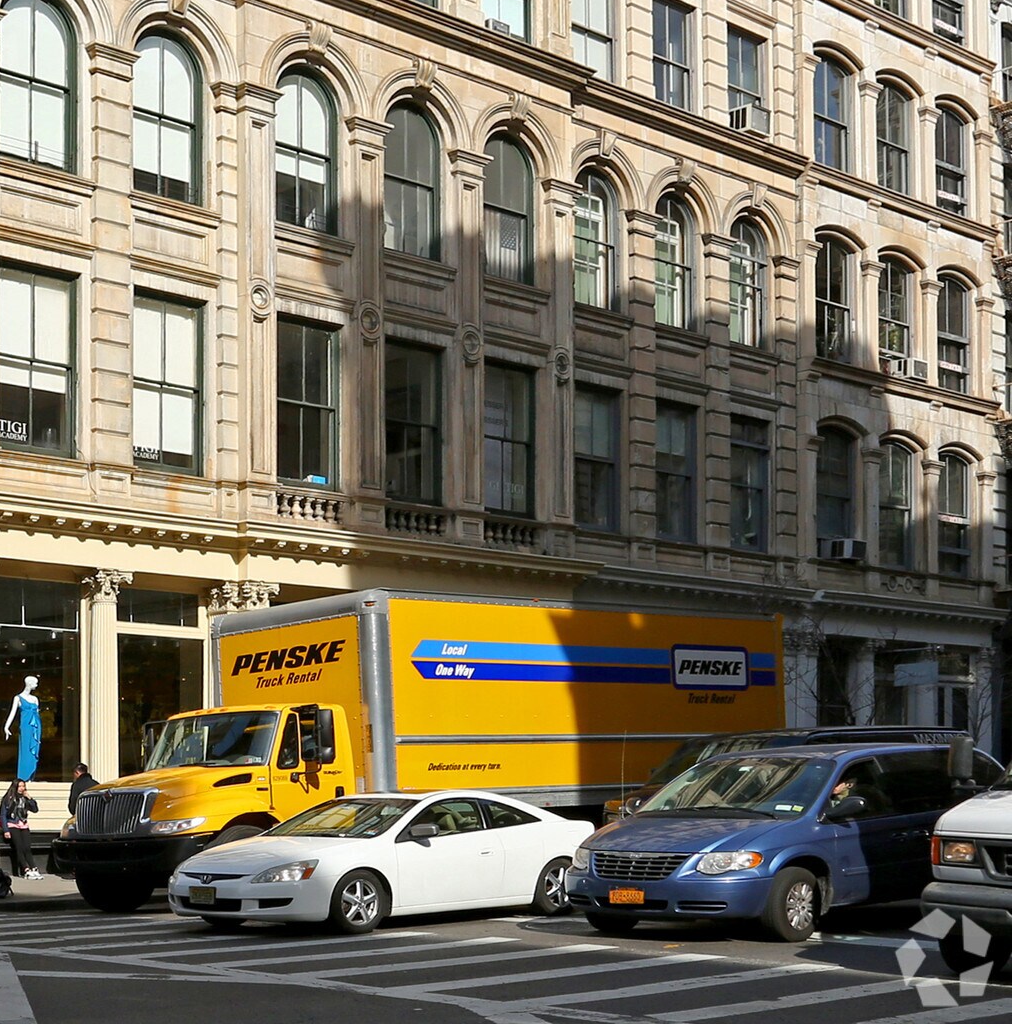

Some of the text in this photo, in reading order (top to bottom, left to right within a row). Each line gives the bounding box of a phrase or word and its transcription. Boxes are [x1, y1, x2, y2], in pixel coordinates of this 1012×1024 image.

[441, 643, 468, 656] Local
[231, 639, 347, 677] PENSKE
[435, 663, 475, 679] One Way
[678, 659, 744, 676] PENSKE
[255, 668, 323, 689] Truck Rental
[688, 692, 737, 705] Truck Rental
[428, 762, 461, 772] Dedication
[462, 763, 469, 771] at
[470, 763, 487, 772] every
